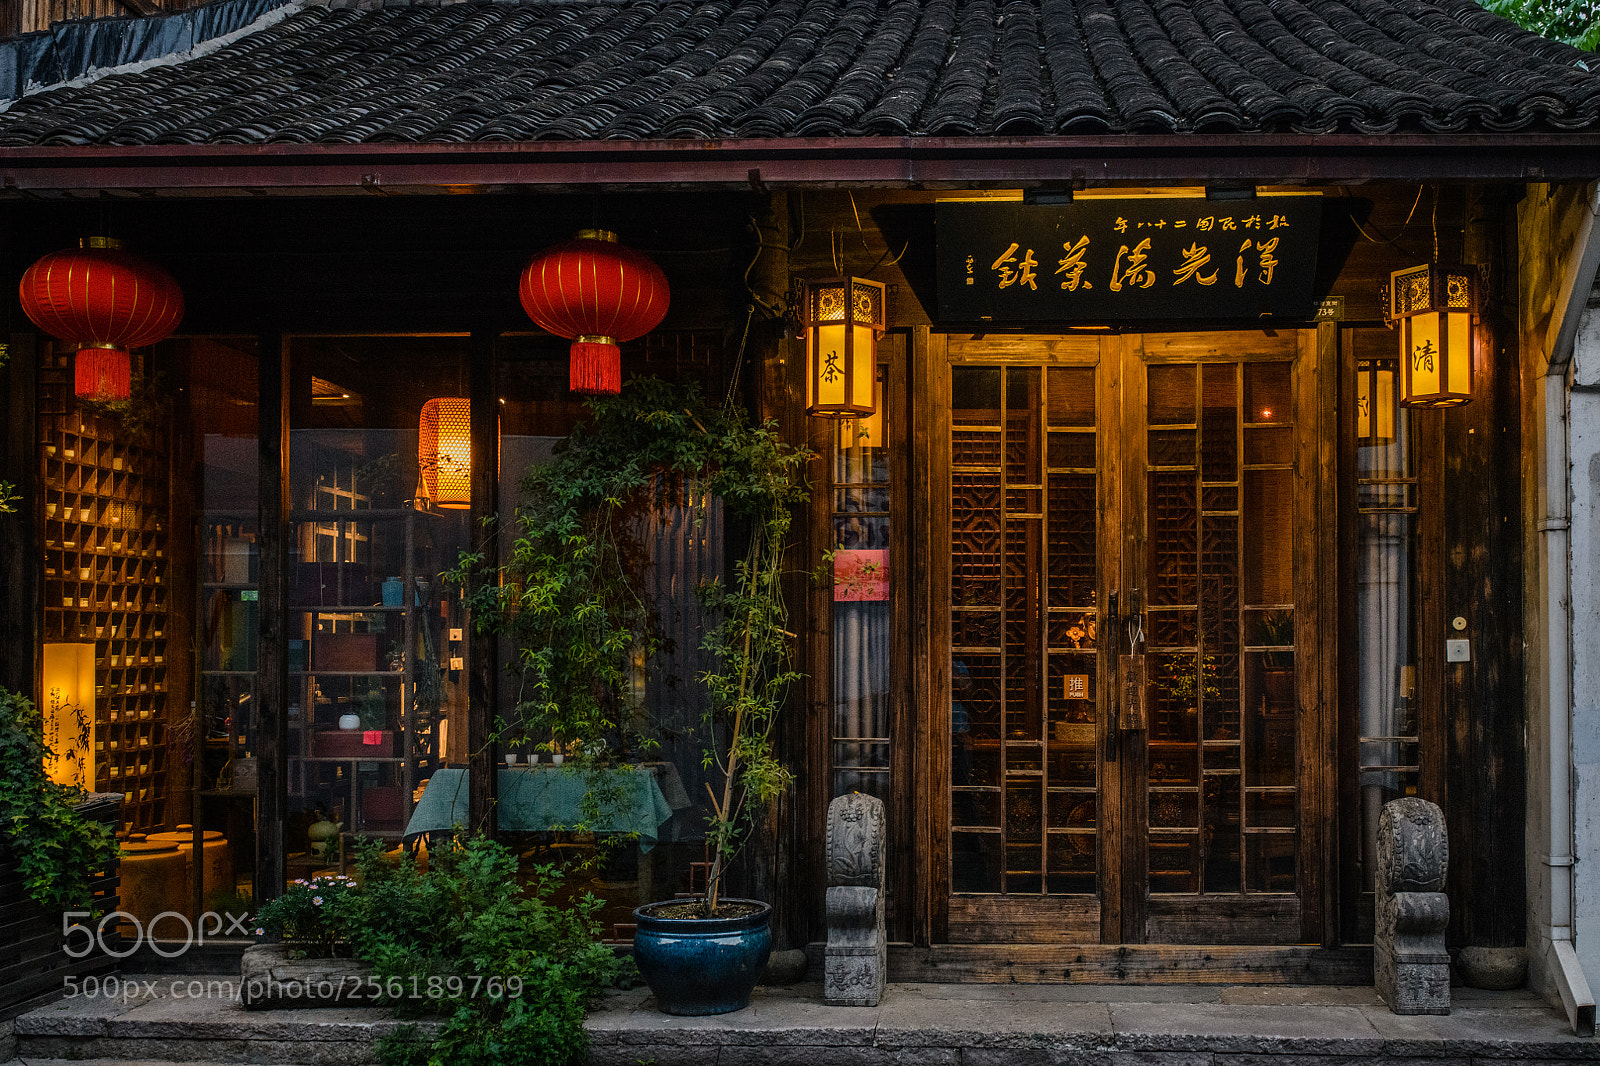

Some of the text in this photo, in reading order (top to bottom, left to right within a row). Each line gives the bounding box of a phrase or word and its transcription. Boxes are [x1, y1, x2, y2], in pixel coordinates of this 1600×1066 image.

[820, 350, 845, 384] 茶
[1413, 339, 1438, 374] 清
[1069, 676, 1084, 691] 推
